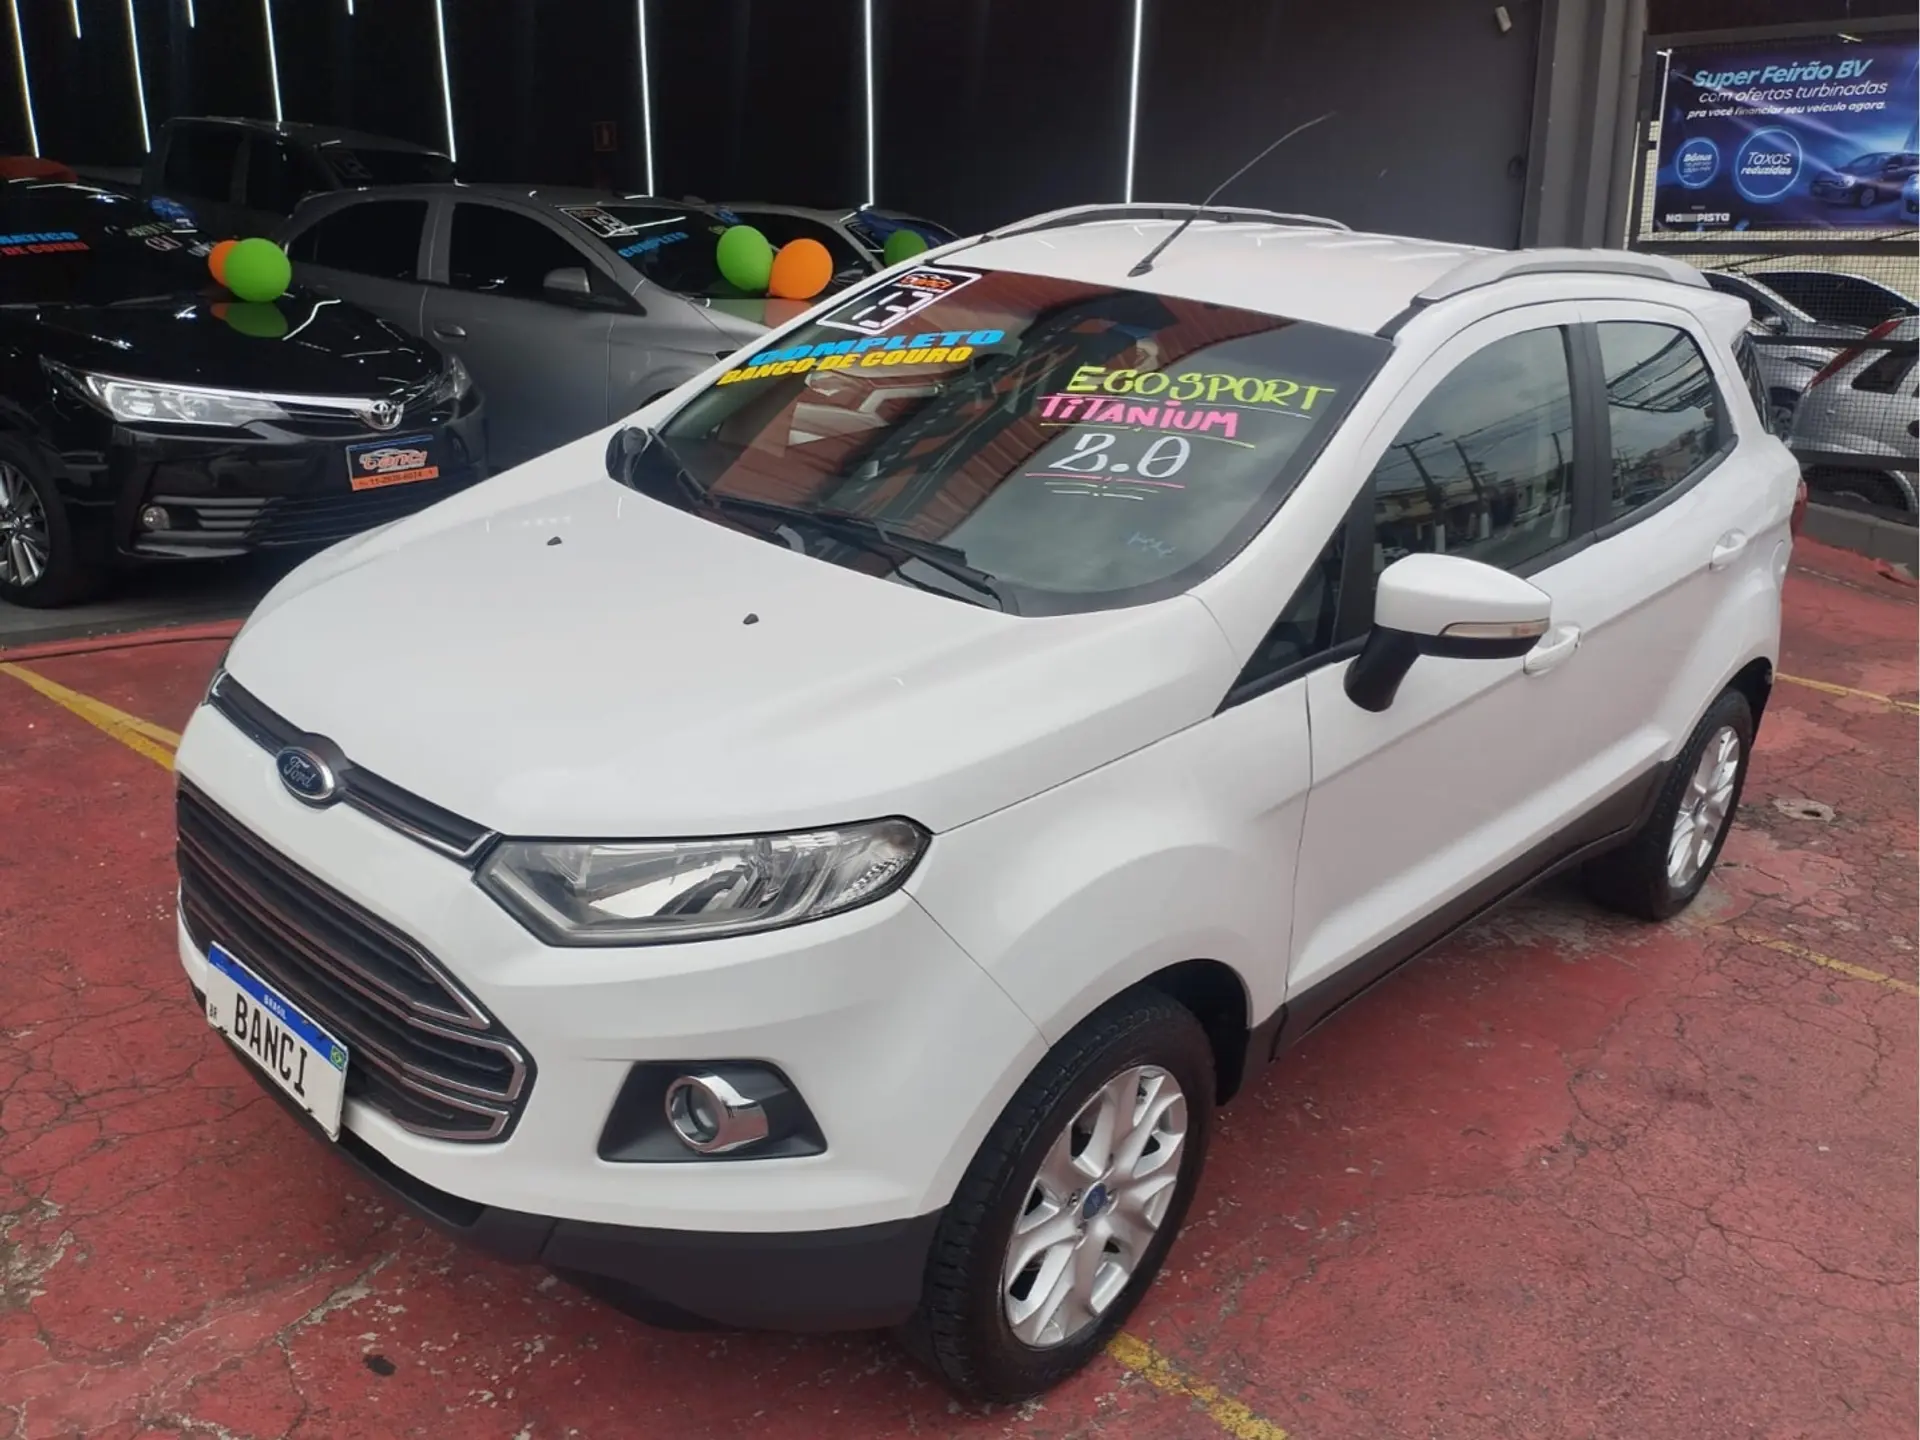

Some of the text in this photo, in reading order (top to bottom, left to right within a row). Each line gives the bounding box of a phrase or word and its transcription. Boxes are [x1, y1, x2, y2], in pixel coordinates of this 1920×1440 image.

[1693, 59, 1873, 89] Super Feirão BV
[1699, 81, 1888, 103] com ofertas turbinadas
[1686, 108, 1706, 120] pra
[1708, 106, 1733, 117] você
[1734, 105, 1783, 117] financiar
[1784, 105, 1804, 115] seu
[1806, 102, 1846, 113] veículo
[1741, 165, 1792, 175] reduzidas
[1747, 151, 1792, 165] Taxas
[748, 329, 1006, 366] COMPLETO
[716, 347, 973, 386] BANCO DE COURO
[1049, 433, 1191, 478] 2.0
[284, 756, 317, 788] Ford
[263, 994, 287, 1020] BRASIL
[234, 993, 308, 1098] BANCI
